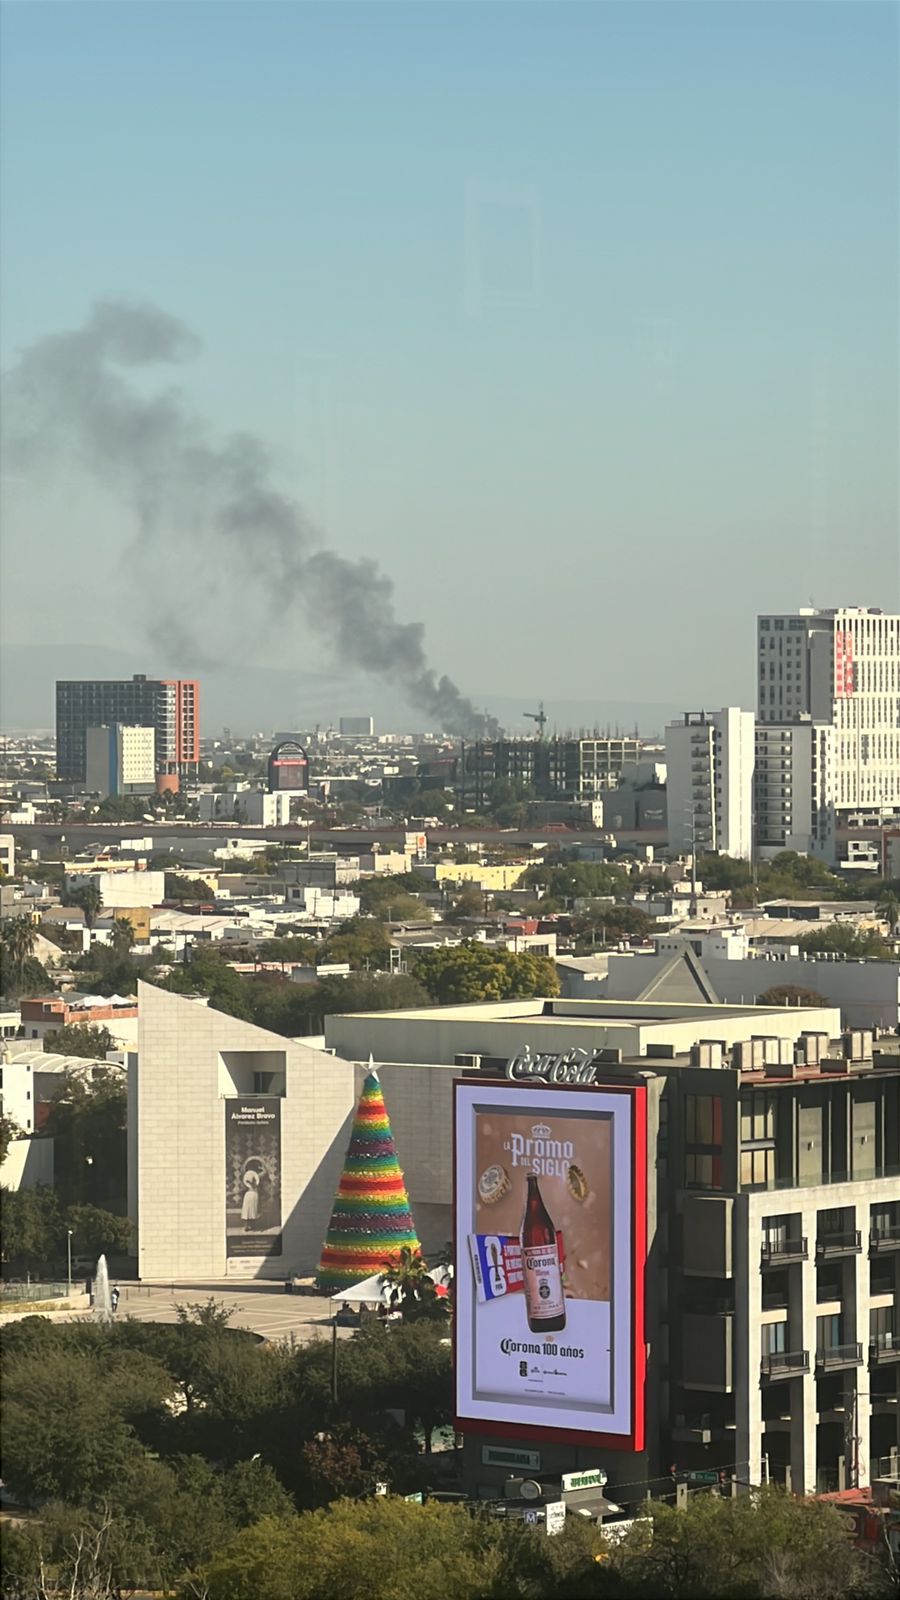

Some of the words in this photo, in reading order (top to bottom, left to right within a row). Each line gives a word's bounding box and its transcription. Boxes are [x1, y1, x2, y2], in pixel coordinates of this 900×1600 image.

[506, 1045, 602, 1085] Coca-Cola
[503, 1141, 511, 1150] LA
[511, 1132, 573, 1168] Promo
[526, 1256, 556, 1270] Corona
[500, 1338, 541, 1356] Corona
[542, 1343, 558, 1356] 100
